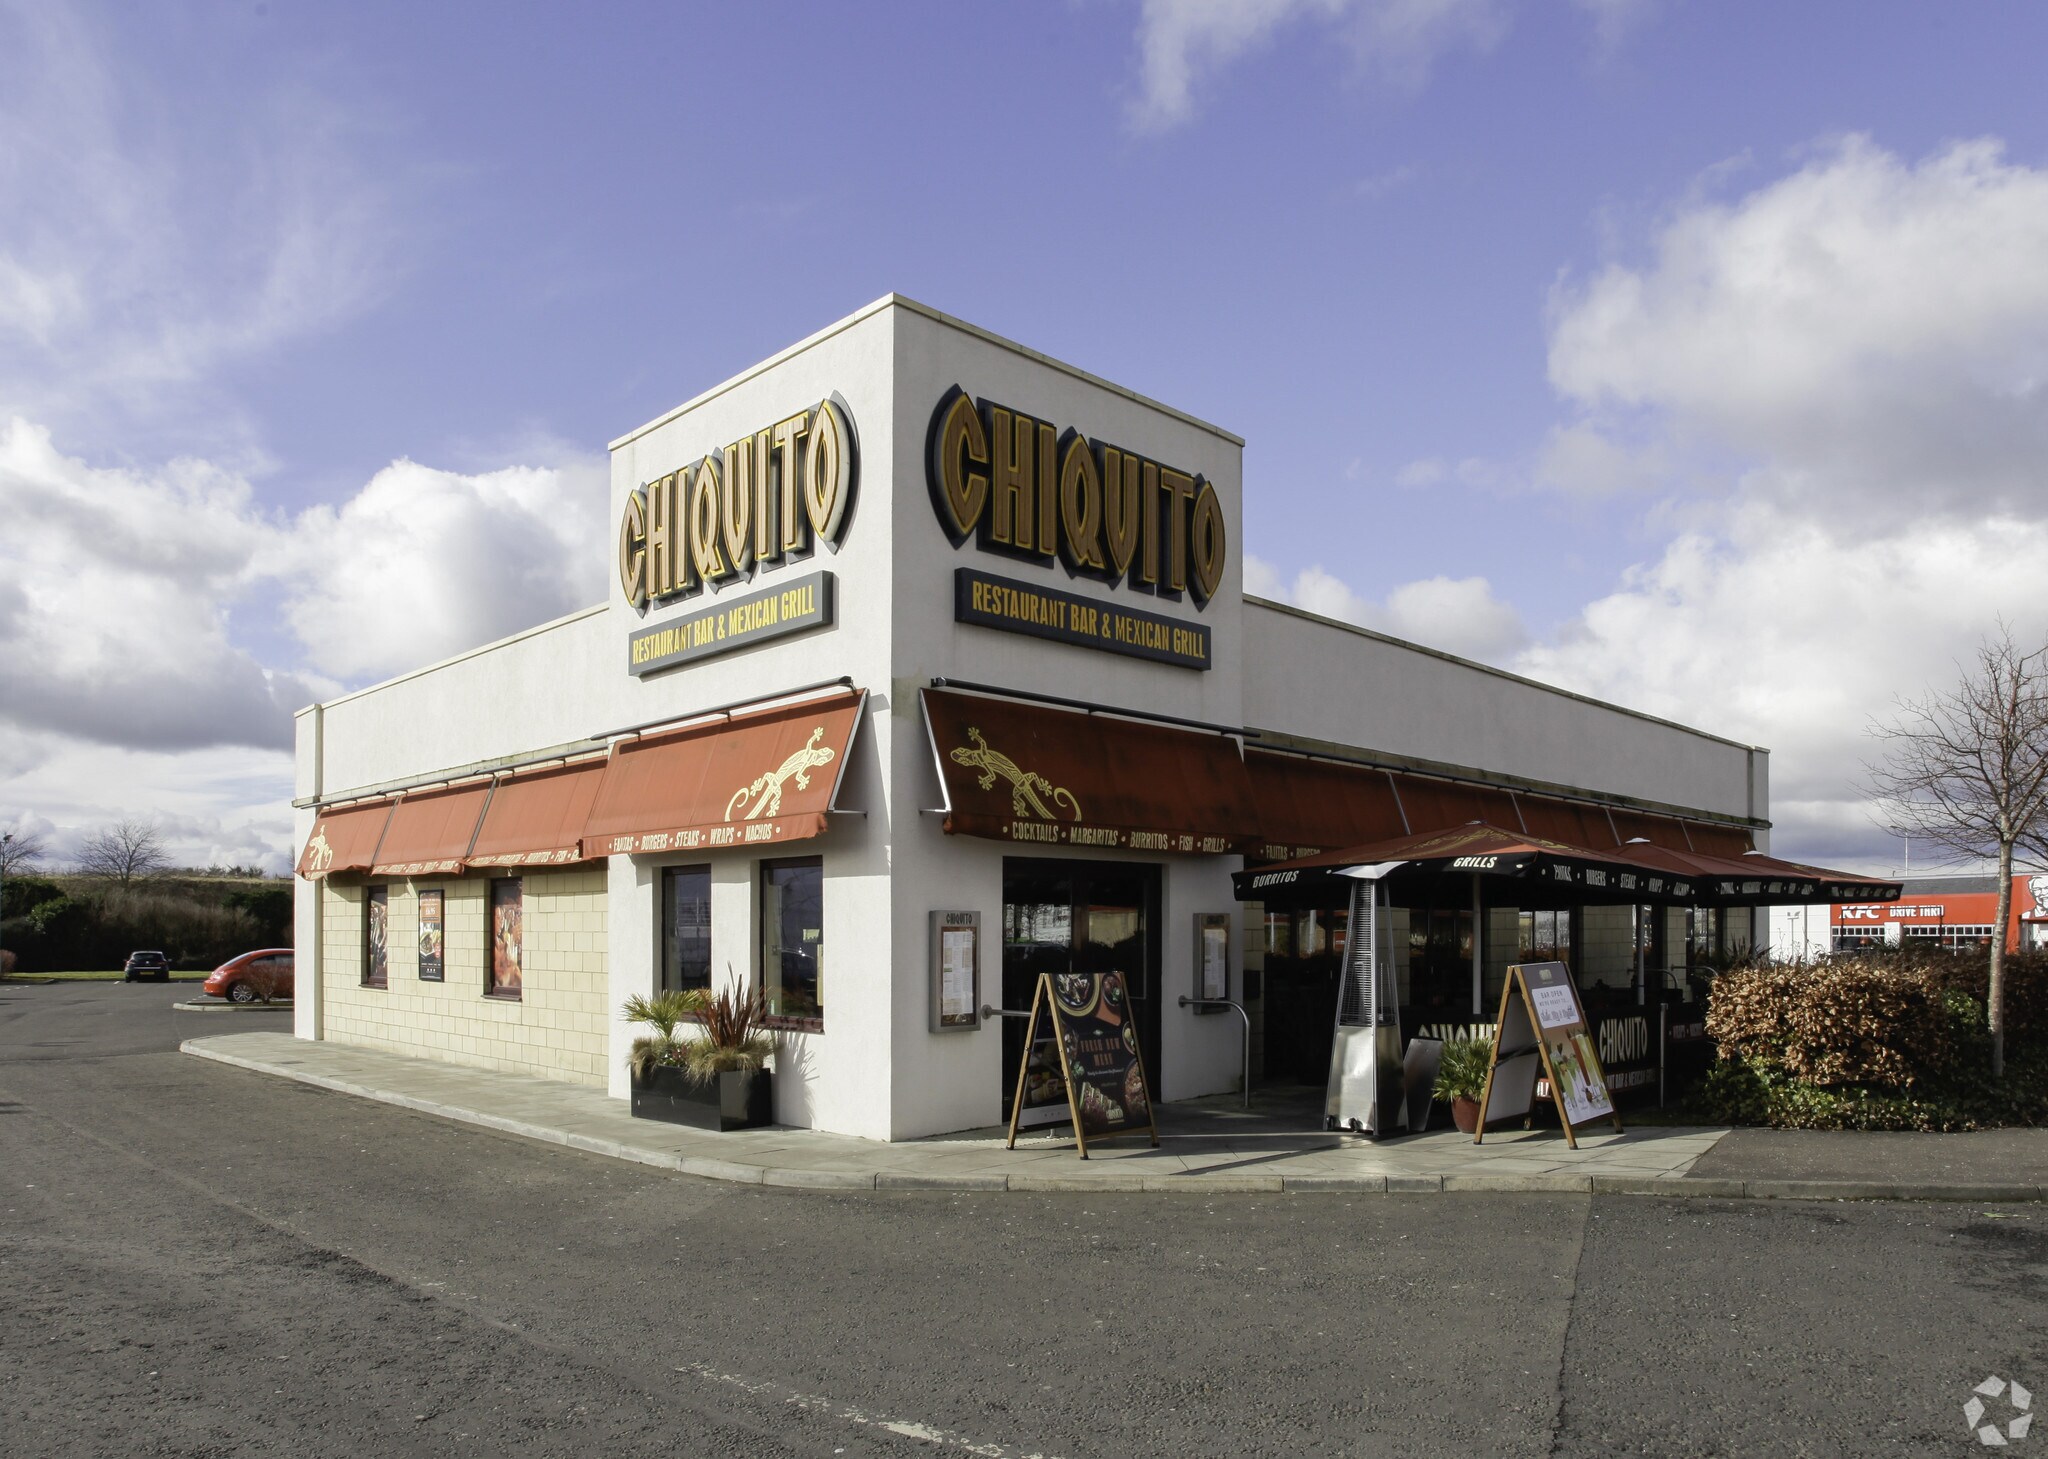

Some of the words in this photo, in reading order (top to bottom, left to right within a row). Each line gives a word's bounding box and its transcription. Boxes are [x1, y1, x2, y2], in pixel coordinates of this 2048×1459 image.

[619, 397, 850, 609] CHIQUITO
[938, 390, 1226, 601] CHIQUITO
[633, 623, 691, 665] RESTAURANT
[694, 615, 714, 647] BAR
[717, 614, 726, 640] &
[729, 596, 778, 637] MEXICAN
[781, 584, 815, 622] GRILL
[972, 580, 1066, 629] RESTAURANT
[1070, 604, 1097, 636] BAR
[1101, 612, 1111, 639] &
[1115, 615, 1169, 651] MEXICAN
[1173, 628, 1206, 659] GRILL
[675, 830, 700, 848] STEAKS
[709, 827, 735, 845] WRAPS
[745, 823, 773, 842] NACHOS
[1012, 821, 1059, 843] COCKTAILS
[1070, 826, 1119, 846] MARGARITAS
[1130, 831, 1168, 850] BURRITOS
[1178, 835, 1194, 851] FISH
[1202, 837, 1226, 853] GRILLS
[1266, 844, 1288, 861] FAJITAS
[1453, 856, 1498, 868] GRILLS
[1252, 870, 1299, 889] BURRITOS
[945, 912, 973, 925] CHIQUITO
[1839, 904, 1881, 919] KFC
[1889, 905, 1917, 917] DRIVE
[1599, 1016, 1648, 1064] CHIQUITO
